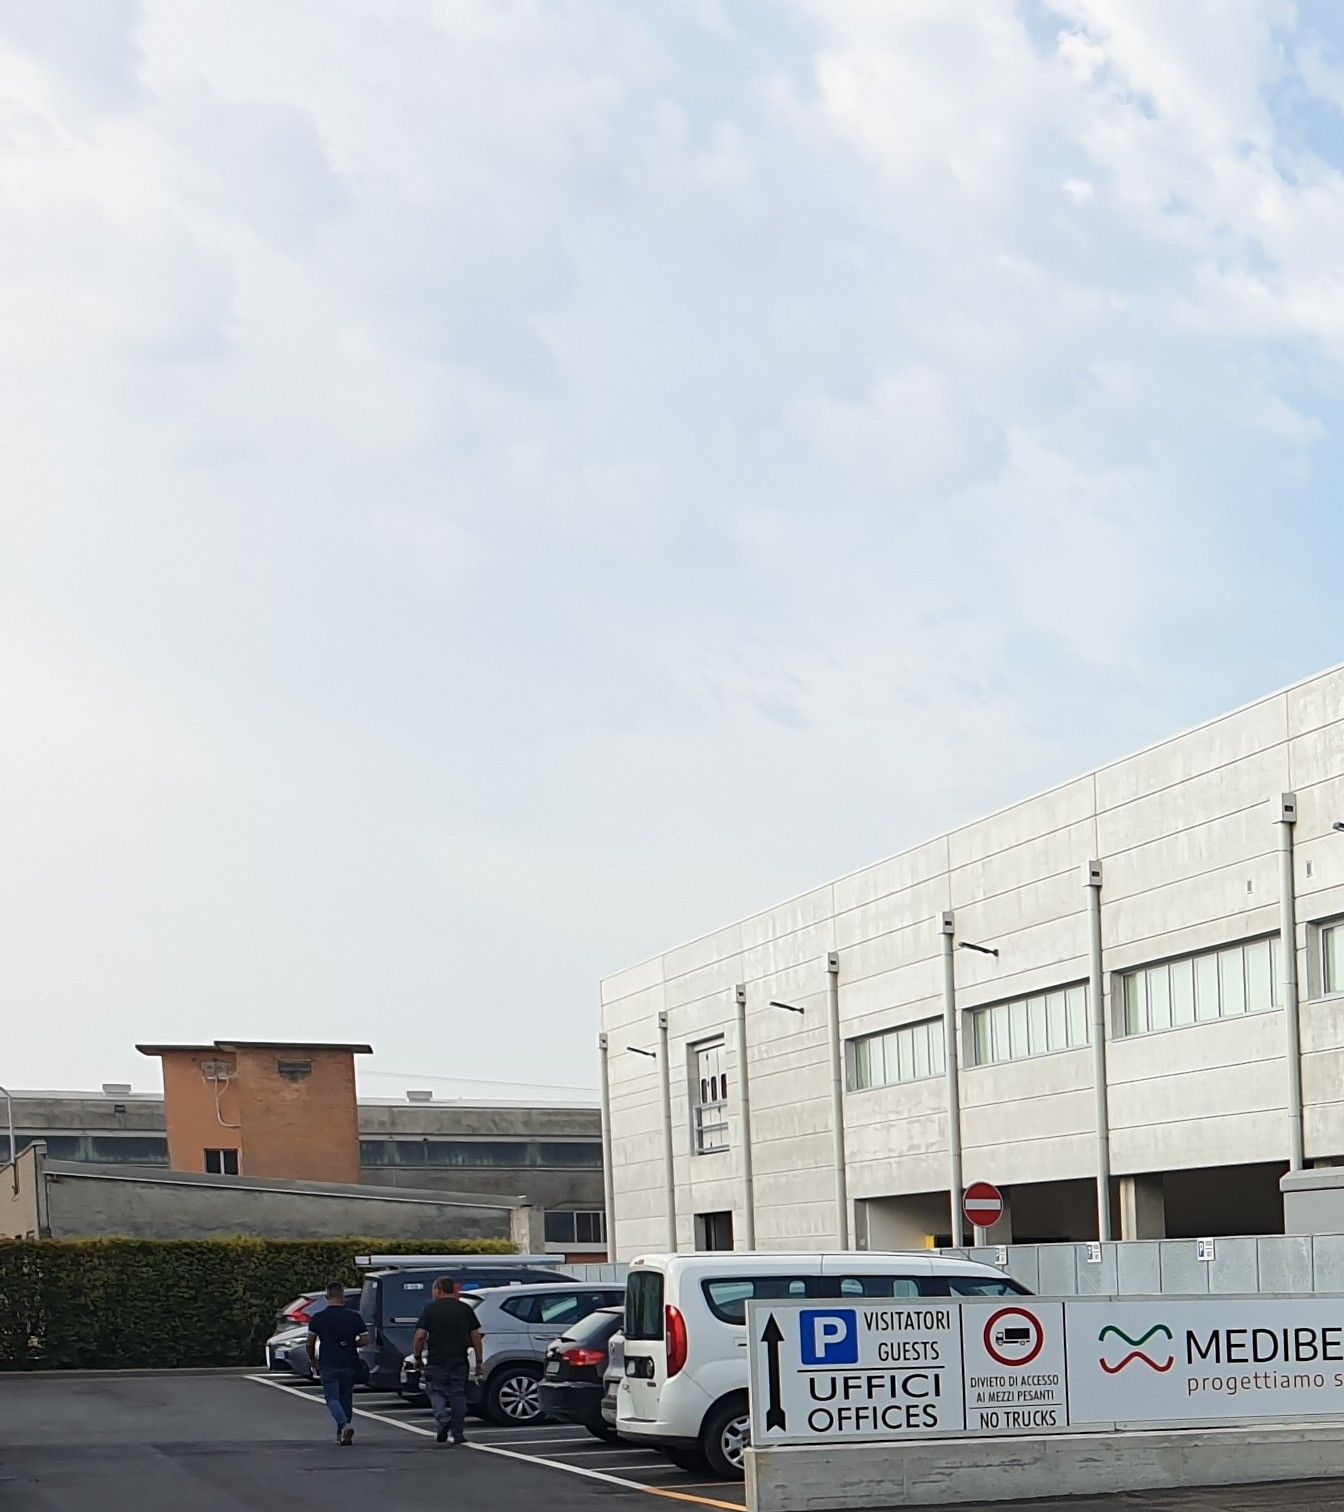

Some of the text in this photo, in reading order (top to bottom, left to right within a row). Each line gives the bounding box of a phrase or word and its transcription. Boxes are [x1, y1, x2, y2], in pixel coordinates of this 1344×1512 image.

[864, 1310, 950, 1332] VISITATORI
[813, 1316, 847, 1358] P
[878, 1340, 940, 1362] GUESTS
[809, 1373, 941, 1401] UFFICI
[970, 1374, 1059, 1388] DIVIETO DI ACCESSO
[1187, 1368, 1325, 1397] progettiamo
[976, 1389, 1054, 1403] AI MEZZI PESANTI
[808, 1403, 938, 1433] OFFICES
[979, 1409, 1057, 1430] NO TRUCKS
